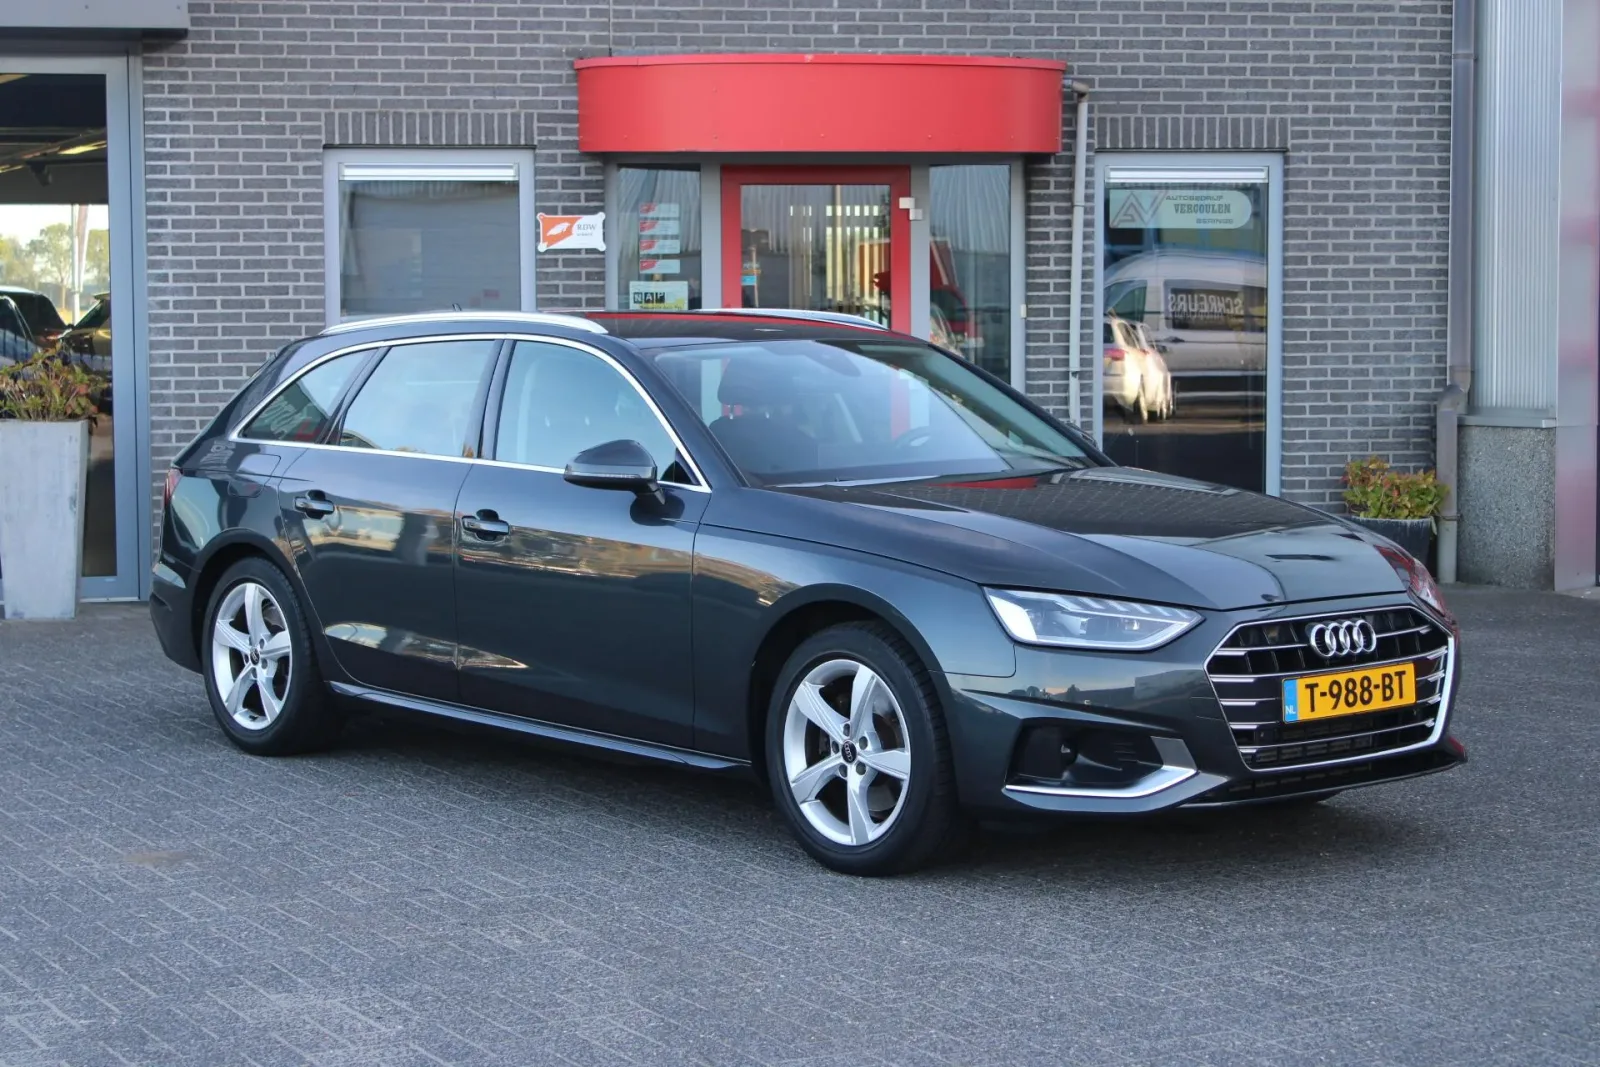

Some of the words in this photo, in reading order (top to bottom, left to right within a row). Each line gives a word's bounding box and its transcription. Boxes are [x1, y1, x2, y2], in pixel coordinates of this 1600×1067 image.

[577, 223, 597, 231] RDW
[633, 292, 665, 303] NAP
[1305, 670, 1406, 712] T-988-BT
[1285, 705, 1296, 714] NL
